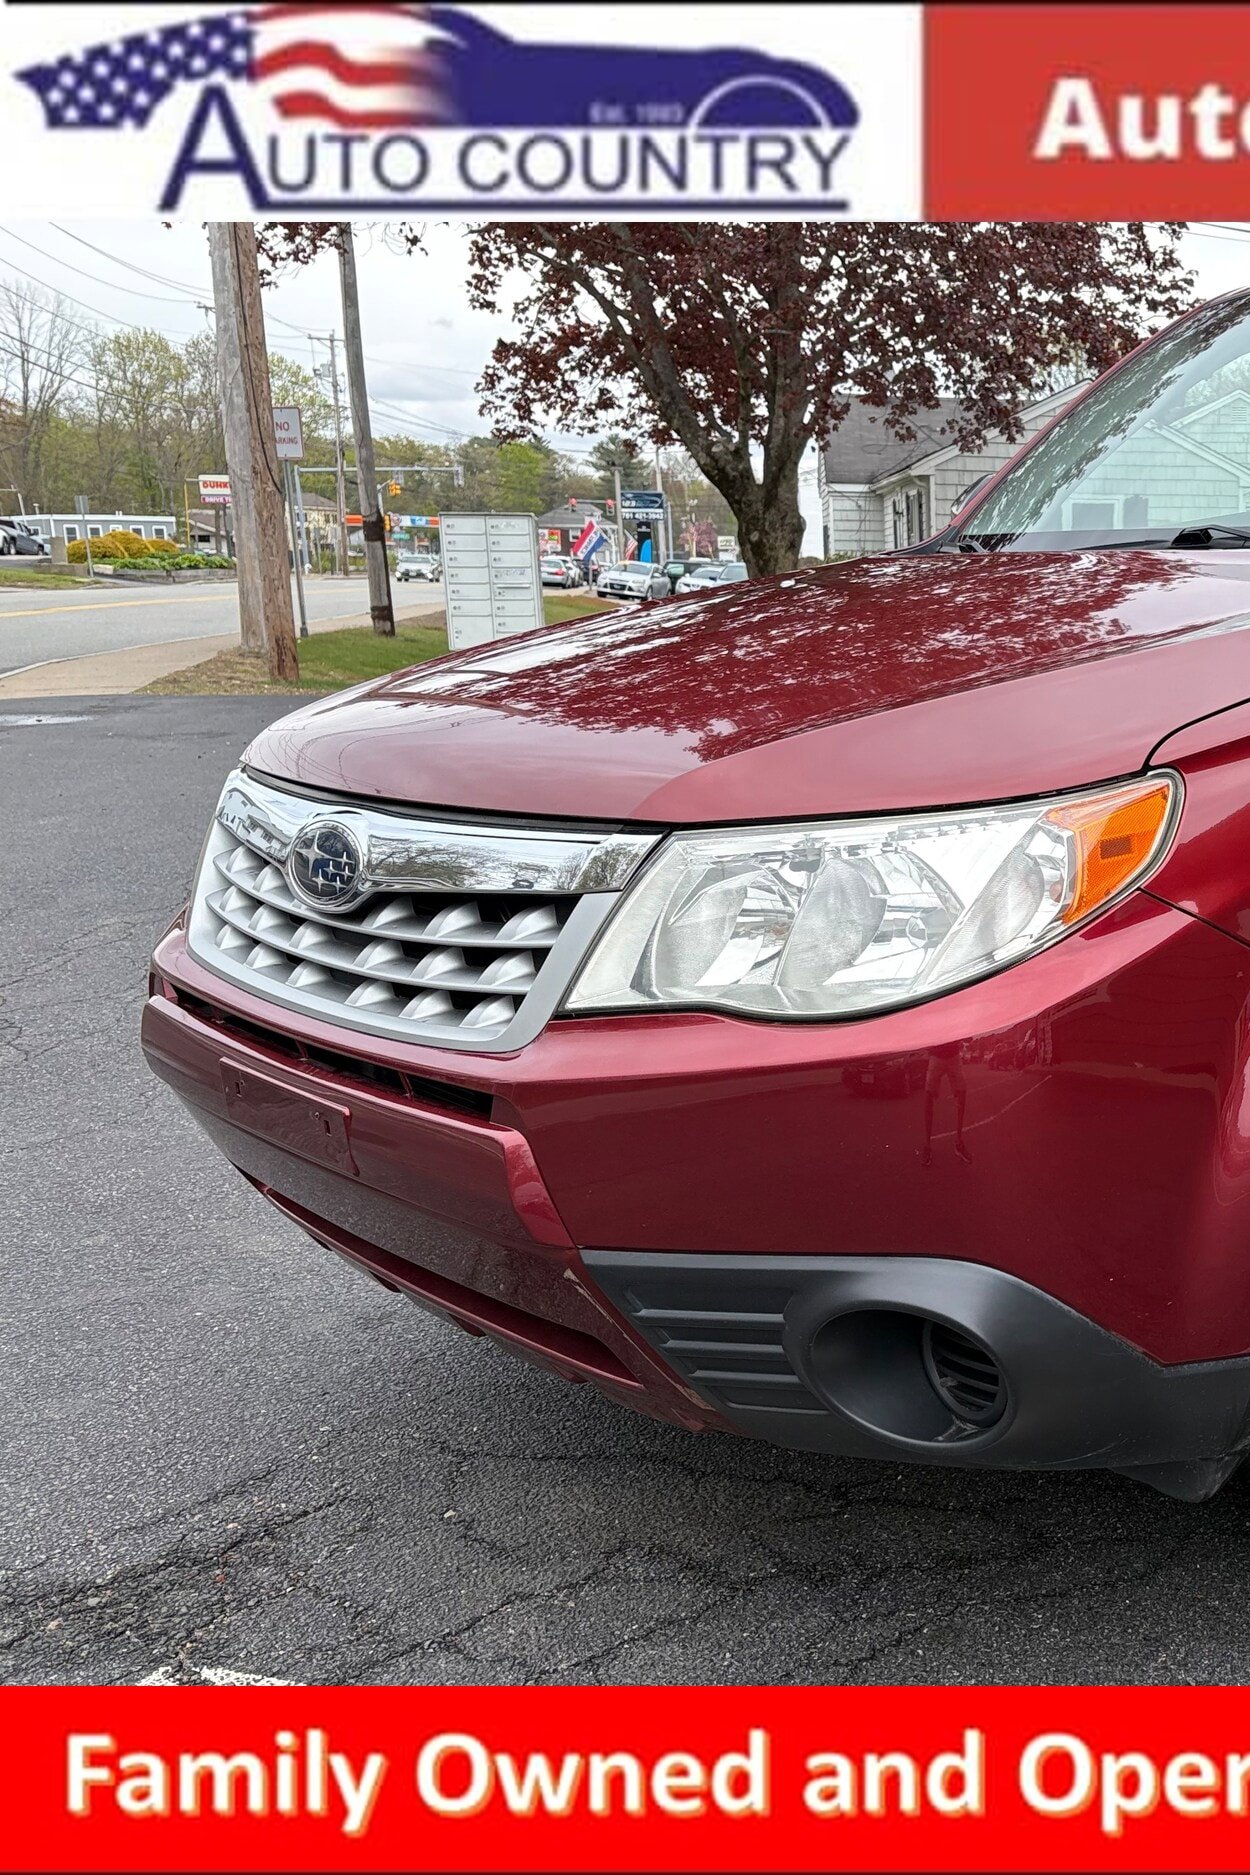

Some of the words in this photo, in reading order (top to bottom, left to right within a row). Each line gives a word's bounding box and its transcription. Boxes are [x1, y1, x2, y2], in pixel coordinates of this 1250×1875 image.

[275, 421, 290, 431] NO
[275, 436, 298, 445] ARKING
[202, 480, 229, 489] DUNK
